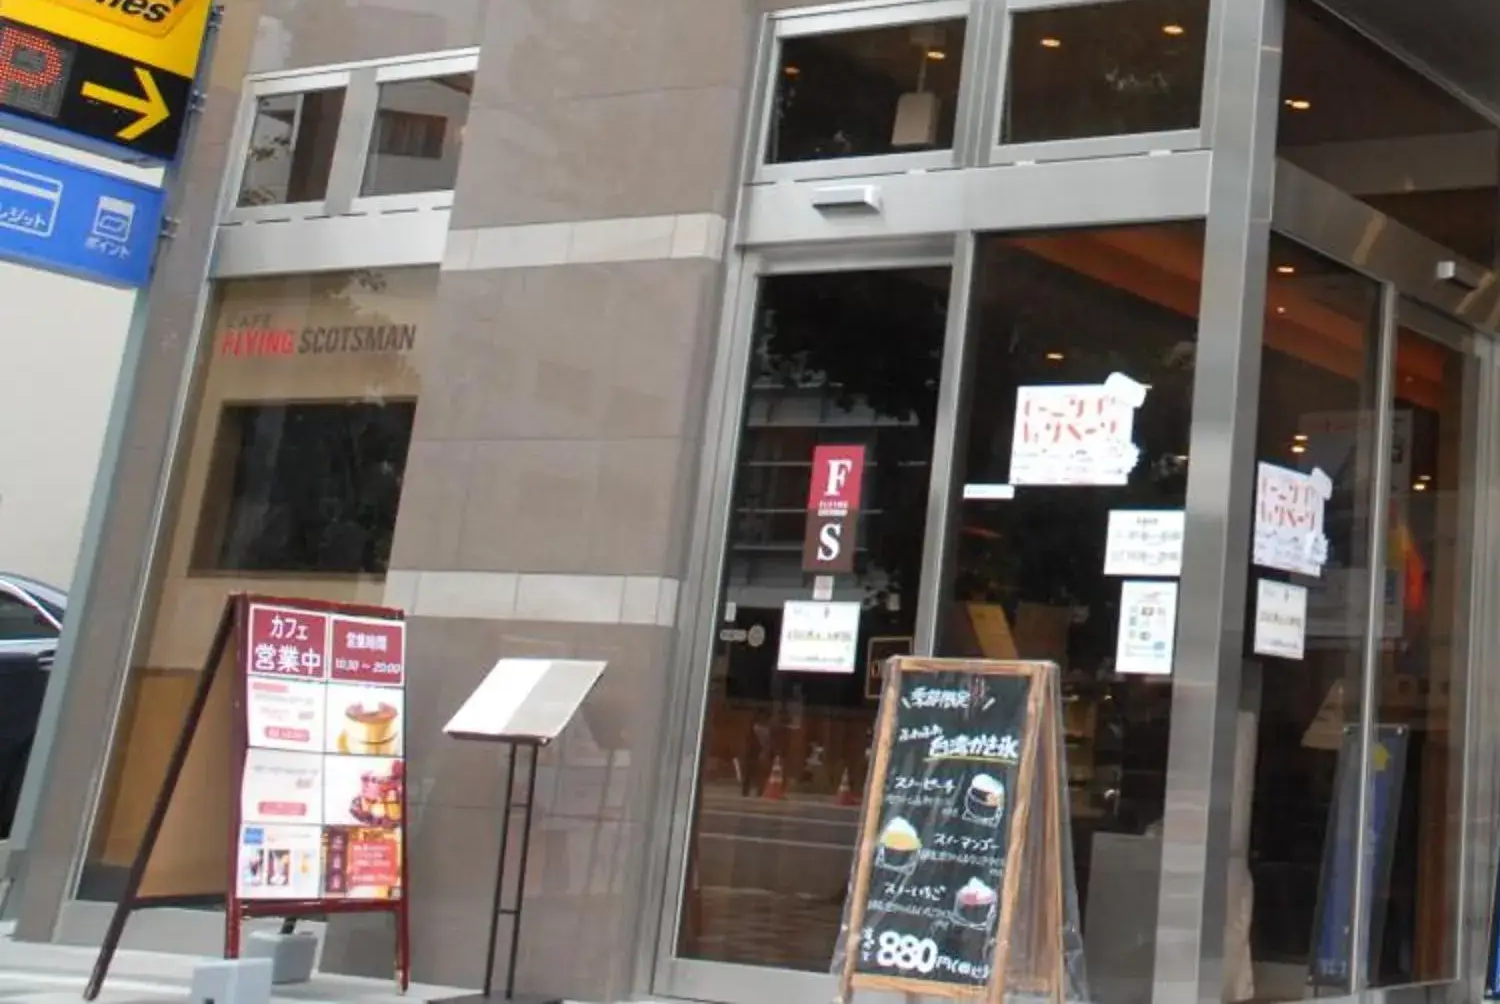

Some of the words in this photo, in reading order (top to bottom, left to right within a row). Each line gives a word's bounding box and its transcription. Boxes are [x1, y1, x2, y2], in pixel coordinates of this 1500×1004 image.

[0, 25, 62, 108] P
[297, 324, 416, 354] SCOTSMAN
[824, 459, 852, 496] F
[817, 523, 841, 561] S
[270, 615, 309, 641] カフェ
[254, 643, 321, 675] 営業中
